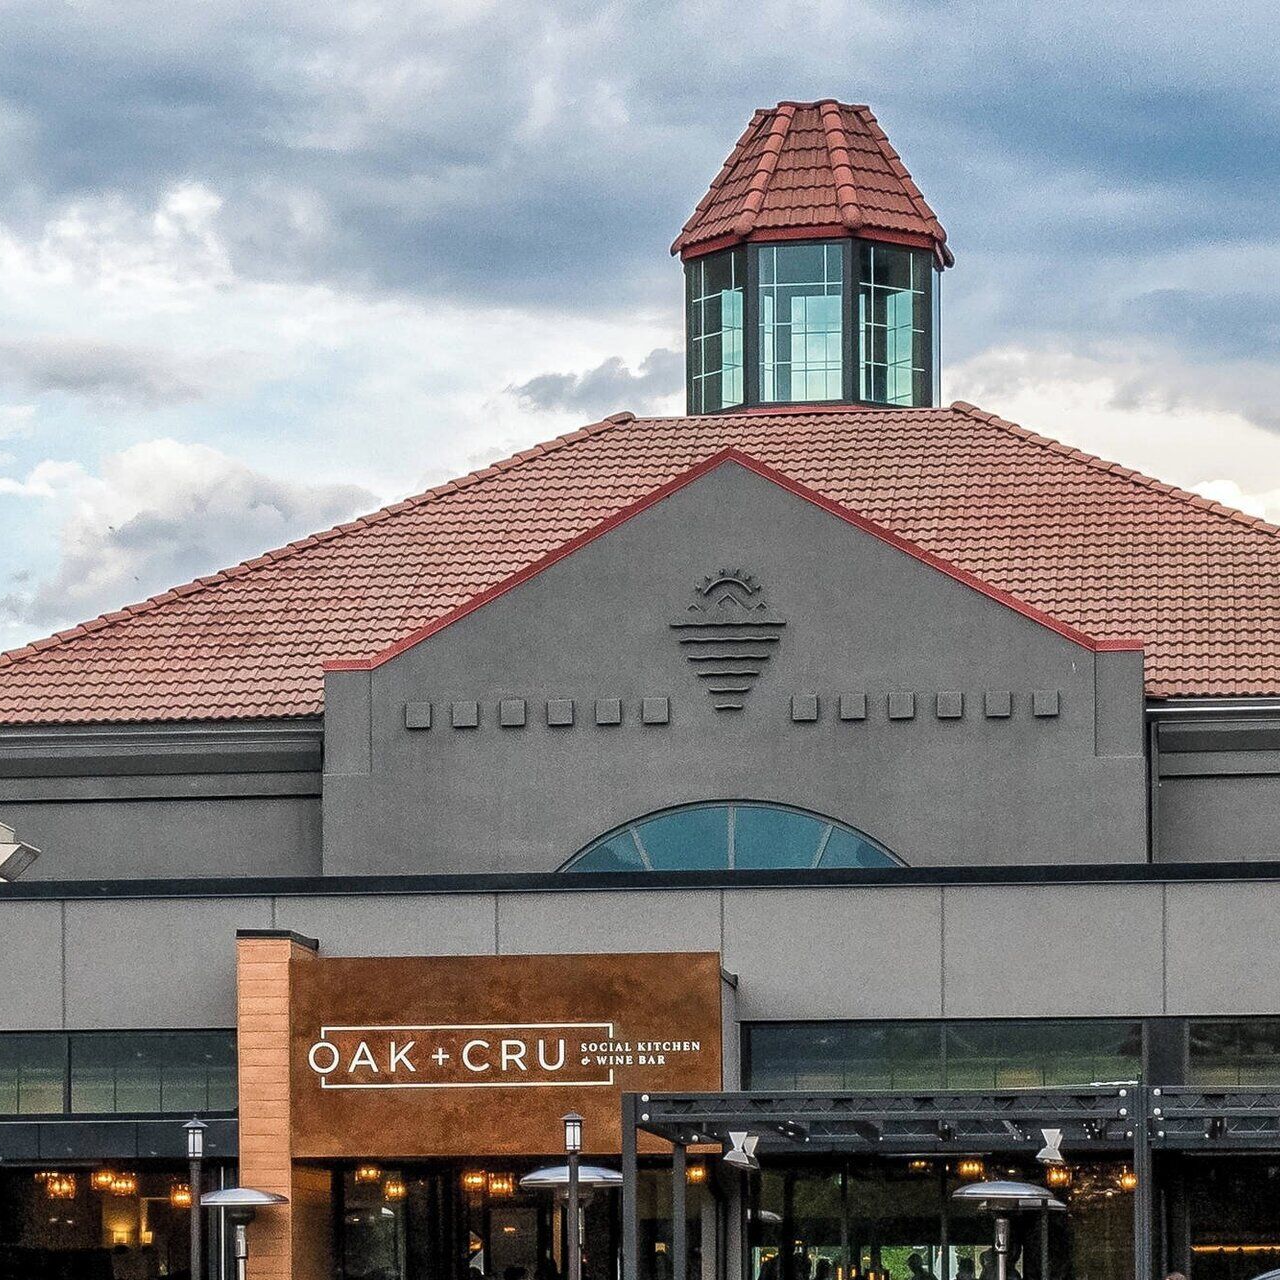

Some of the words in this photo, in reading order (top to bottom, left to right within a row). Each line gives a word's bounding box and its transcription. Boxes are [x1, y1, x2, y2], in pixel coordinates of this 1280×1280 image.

[580, 1042, 632, 1052] SOCIAL
[637, 1041, 700, 1051] KITCHEN
[308, 1041, 417, 1074] OAK
[462, 1038, 565, 1072] CRU
[580, 1056, 591, 1066] &
[596, 1055, 634, 1065] WINE
[638, 1055, 666, 1065] BAR
